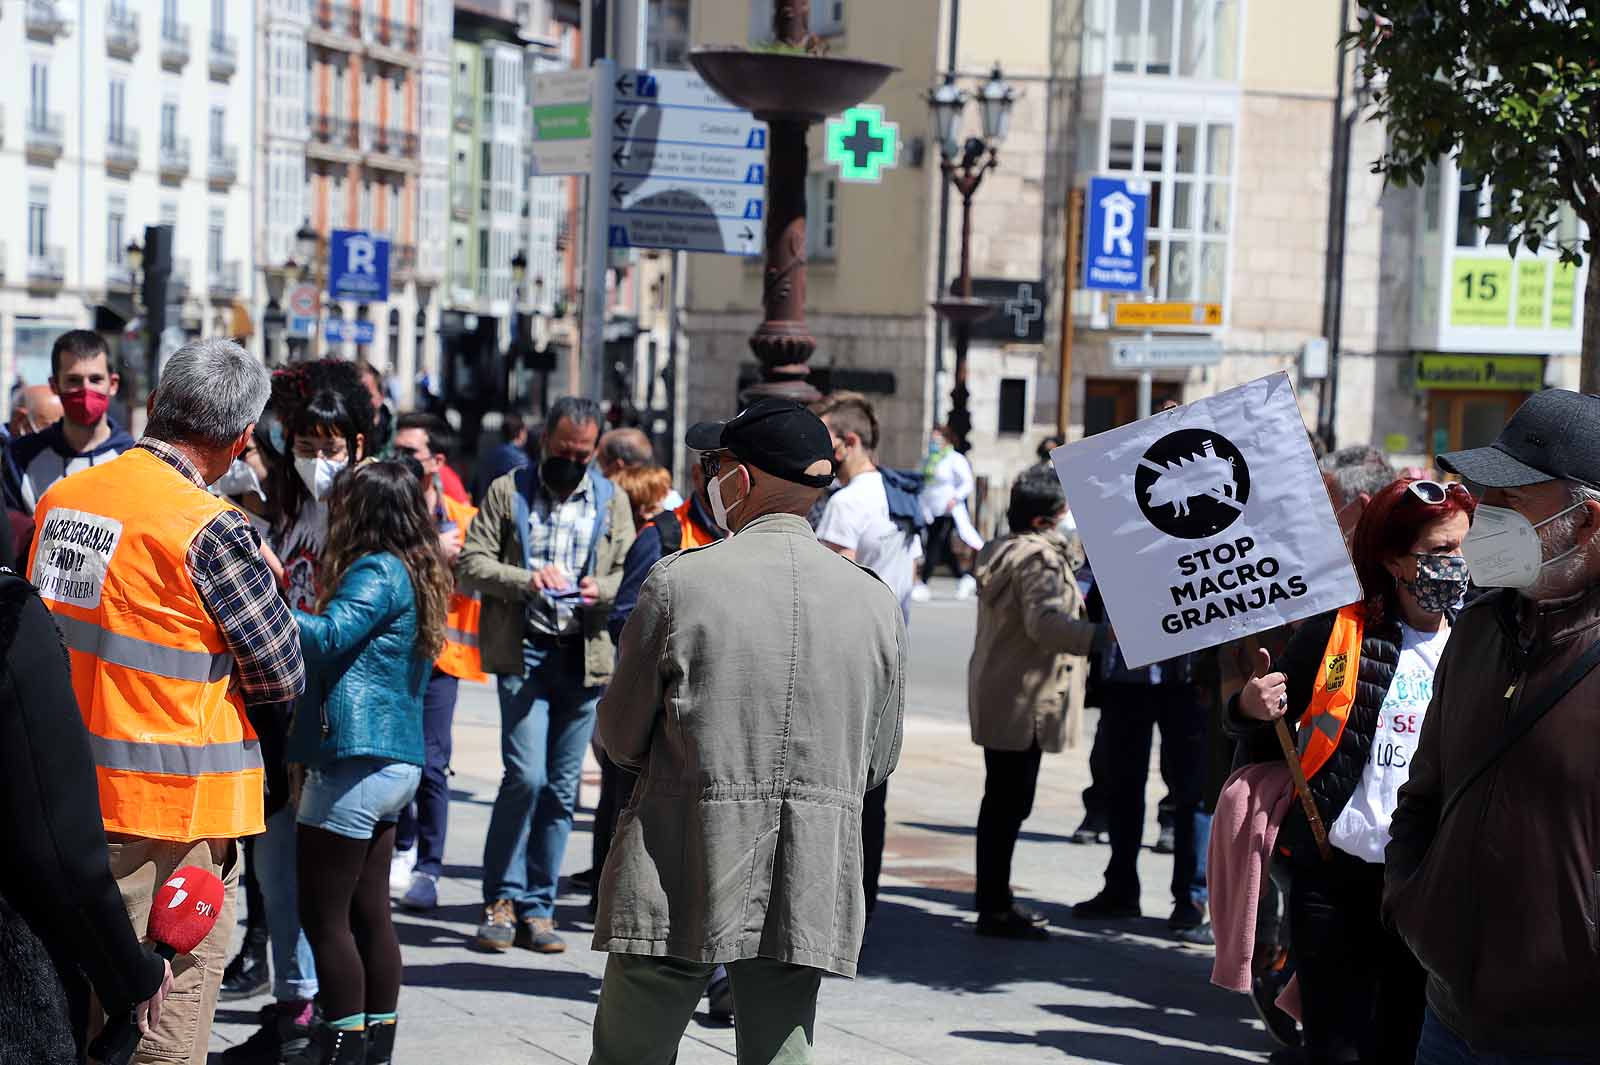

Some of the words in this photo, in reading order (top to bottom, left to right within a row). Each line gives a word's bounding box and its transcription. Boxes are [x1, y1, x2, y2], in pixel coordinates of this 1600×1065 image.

[1460, 272, 1497, 301] 15
[44, 520, 115, 555] MACROGRANJA
[1177, 536, 1255, 577] STOP
[1170, 557, 1279, 606] MACRO
[1161, 576, 1308, 634] GRANJAS
[1393, 714, 1416, 734] SE
[1377, 743, 1406, 768] LOS
